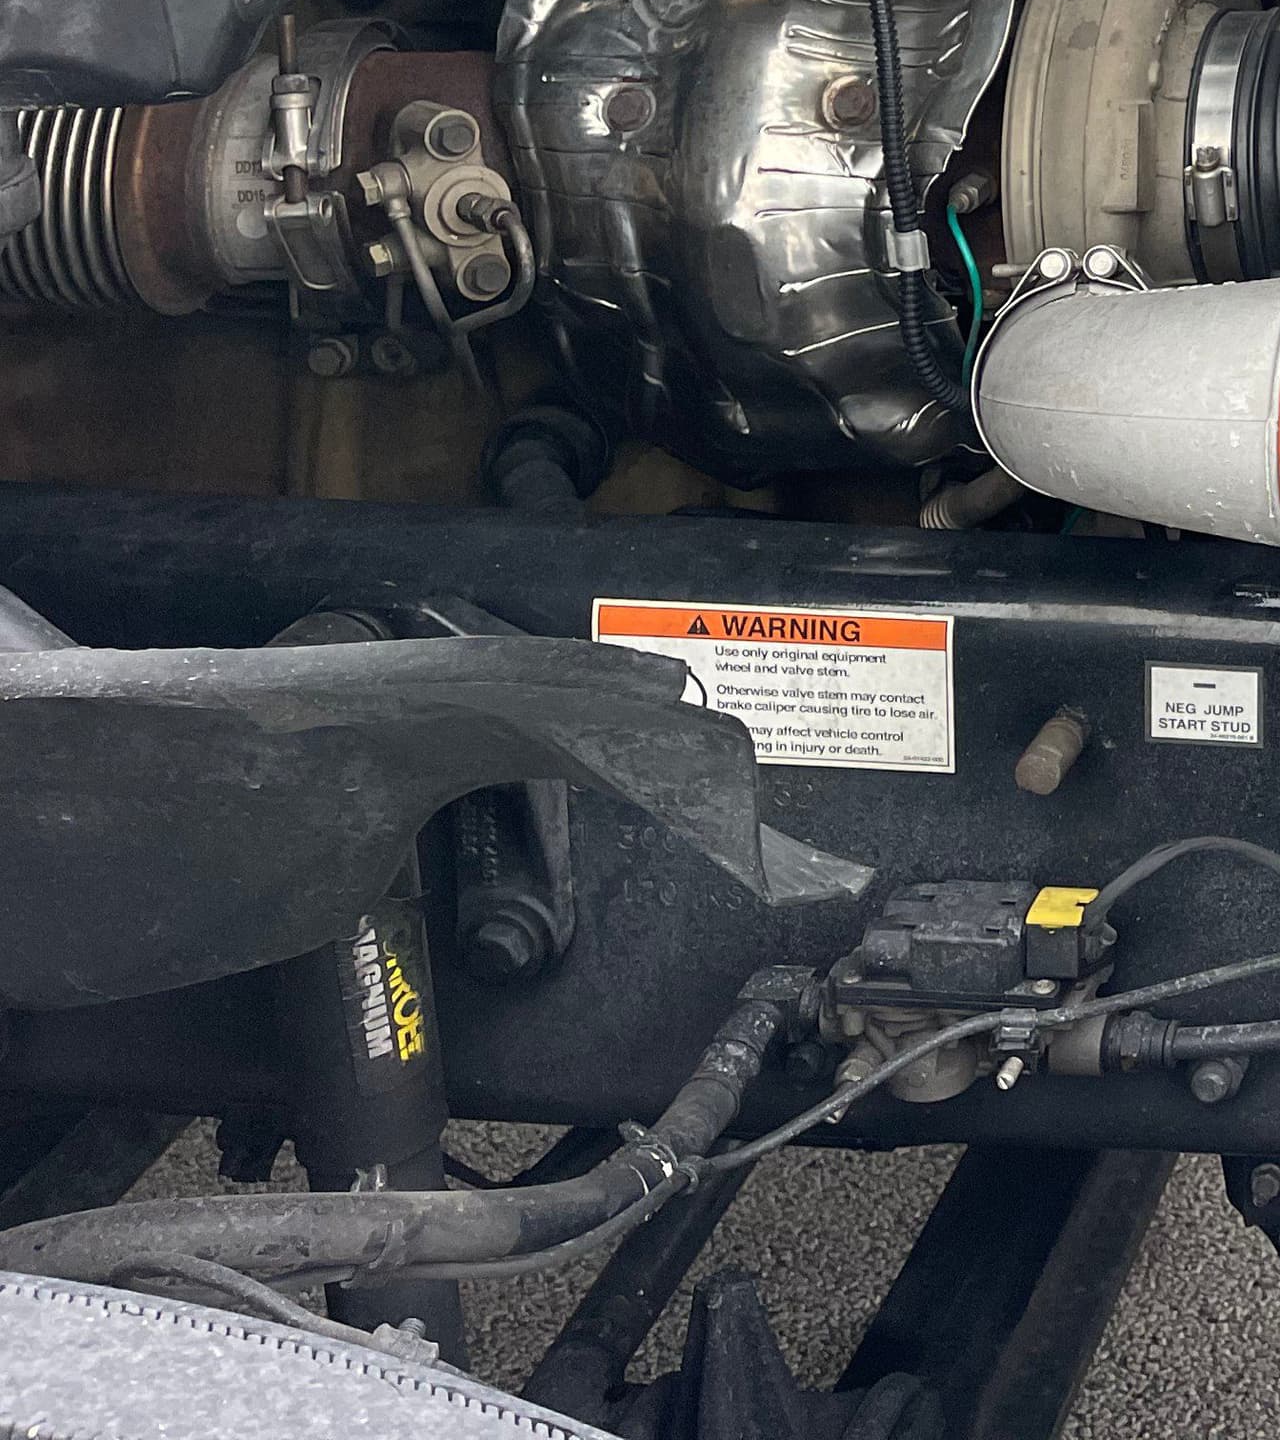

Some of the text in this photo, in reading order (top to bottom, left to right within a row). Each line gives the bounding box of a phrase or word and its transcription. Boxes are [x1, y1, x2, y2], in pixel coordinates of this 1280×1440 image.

[721, 614, 861, 642] WARNING
[715, 645, 887, 665] Use only original equipment
[715, 662, 850, 678] wheel and valve stem.
[716, 684, 925, 705] Otherwise valve stem may contact
[717, 698, 938, 720] brake caliper causing tire to lose air.
[1165, 702, 1244, 717] NEG JUMP
[750, 725, 904, 742] may affect vehicle control
[1159, 717, 1251, 734] START STUD
[775, 741, 788, 752] in
[790, 742, 825, 756] injury
[828, 744, 841, 754] or
[844, 744, 883, 756] death.
